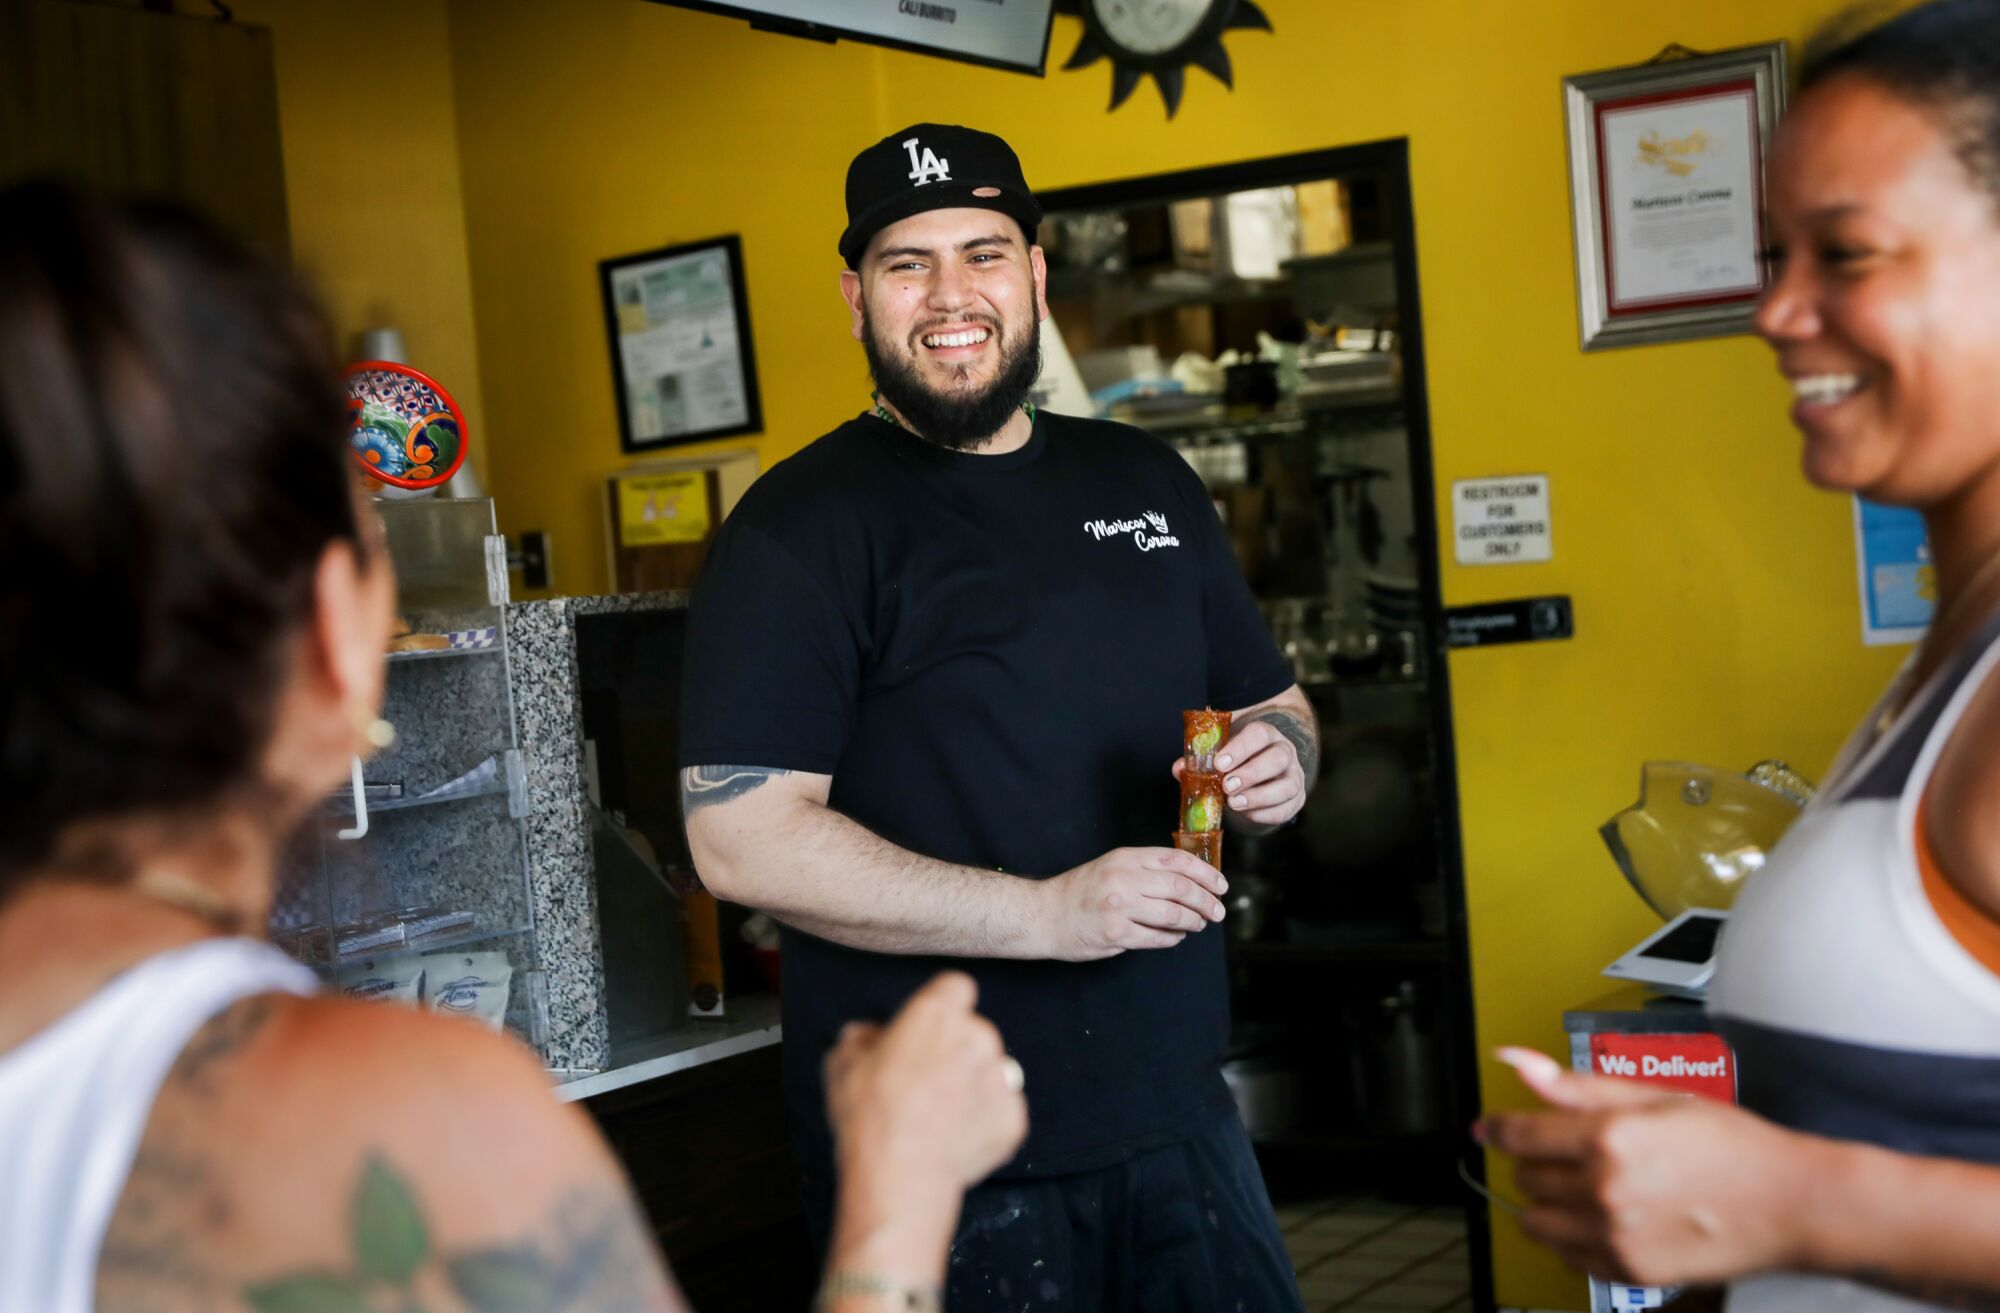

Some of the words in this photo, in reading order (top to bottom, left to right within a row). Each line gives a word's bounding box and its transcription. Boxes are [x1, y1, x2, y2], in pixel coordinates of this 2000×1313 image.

[899, 0, 918, 16] CALI
[919, 2, 956, 23] BURRITO
[902, 138, 952, 187] LA
[1462, 485, 1539, 500] RESTROOM
[1487, 504, 1515, 519] FOR
[1084, 518, 1146, 540] Mariscos
[1460, 521, 1544, 540] CUSTOMERS
[1135, 530, 1179, 551] Corona
[1485, 542, 1520, 557] ONLY
[1599, 1055, 1637, 1076] We
[1641, 1055, 1727, 1077] Deliver!
